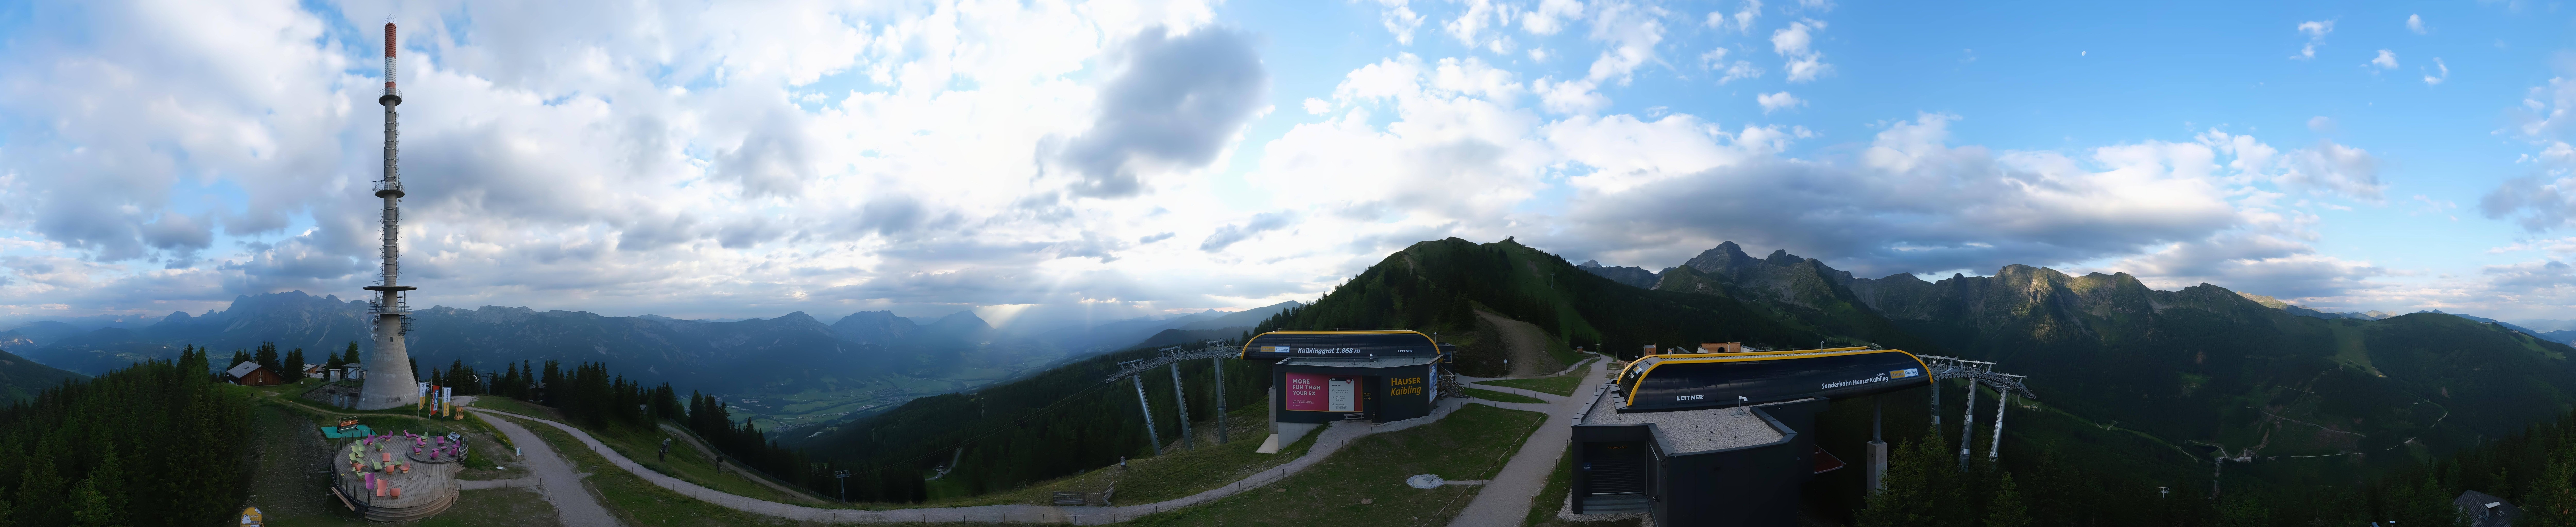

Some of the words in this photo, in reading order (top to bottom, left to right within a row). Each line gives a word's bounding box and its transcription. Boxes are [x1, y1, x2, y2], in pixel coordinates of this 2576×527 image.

[1391, 377, 1421, 386] HAUSER
[1821, 380, 1852, 389] Senderbahn
[1391, 386, 1421, 396] Kaibling
